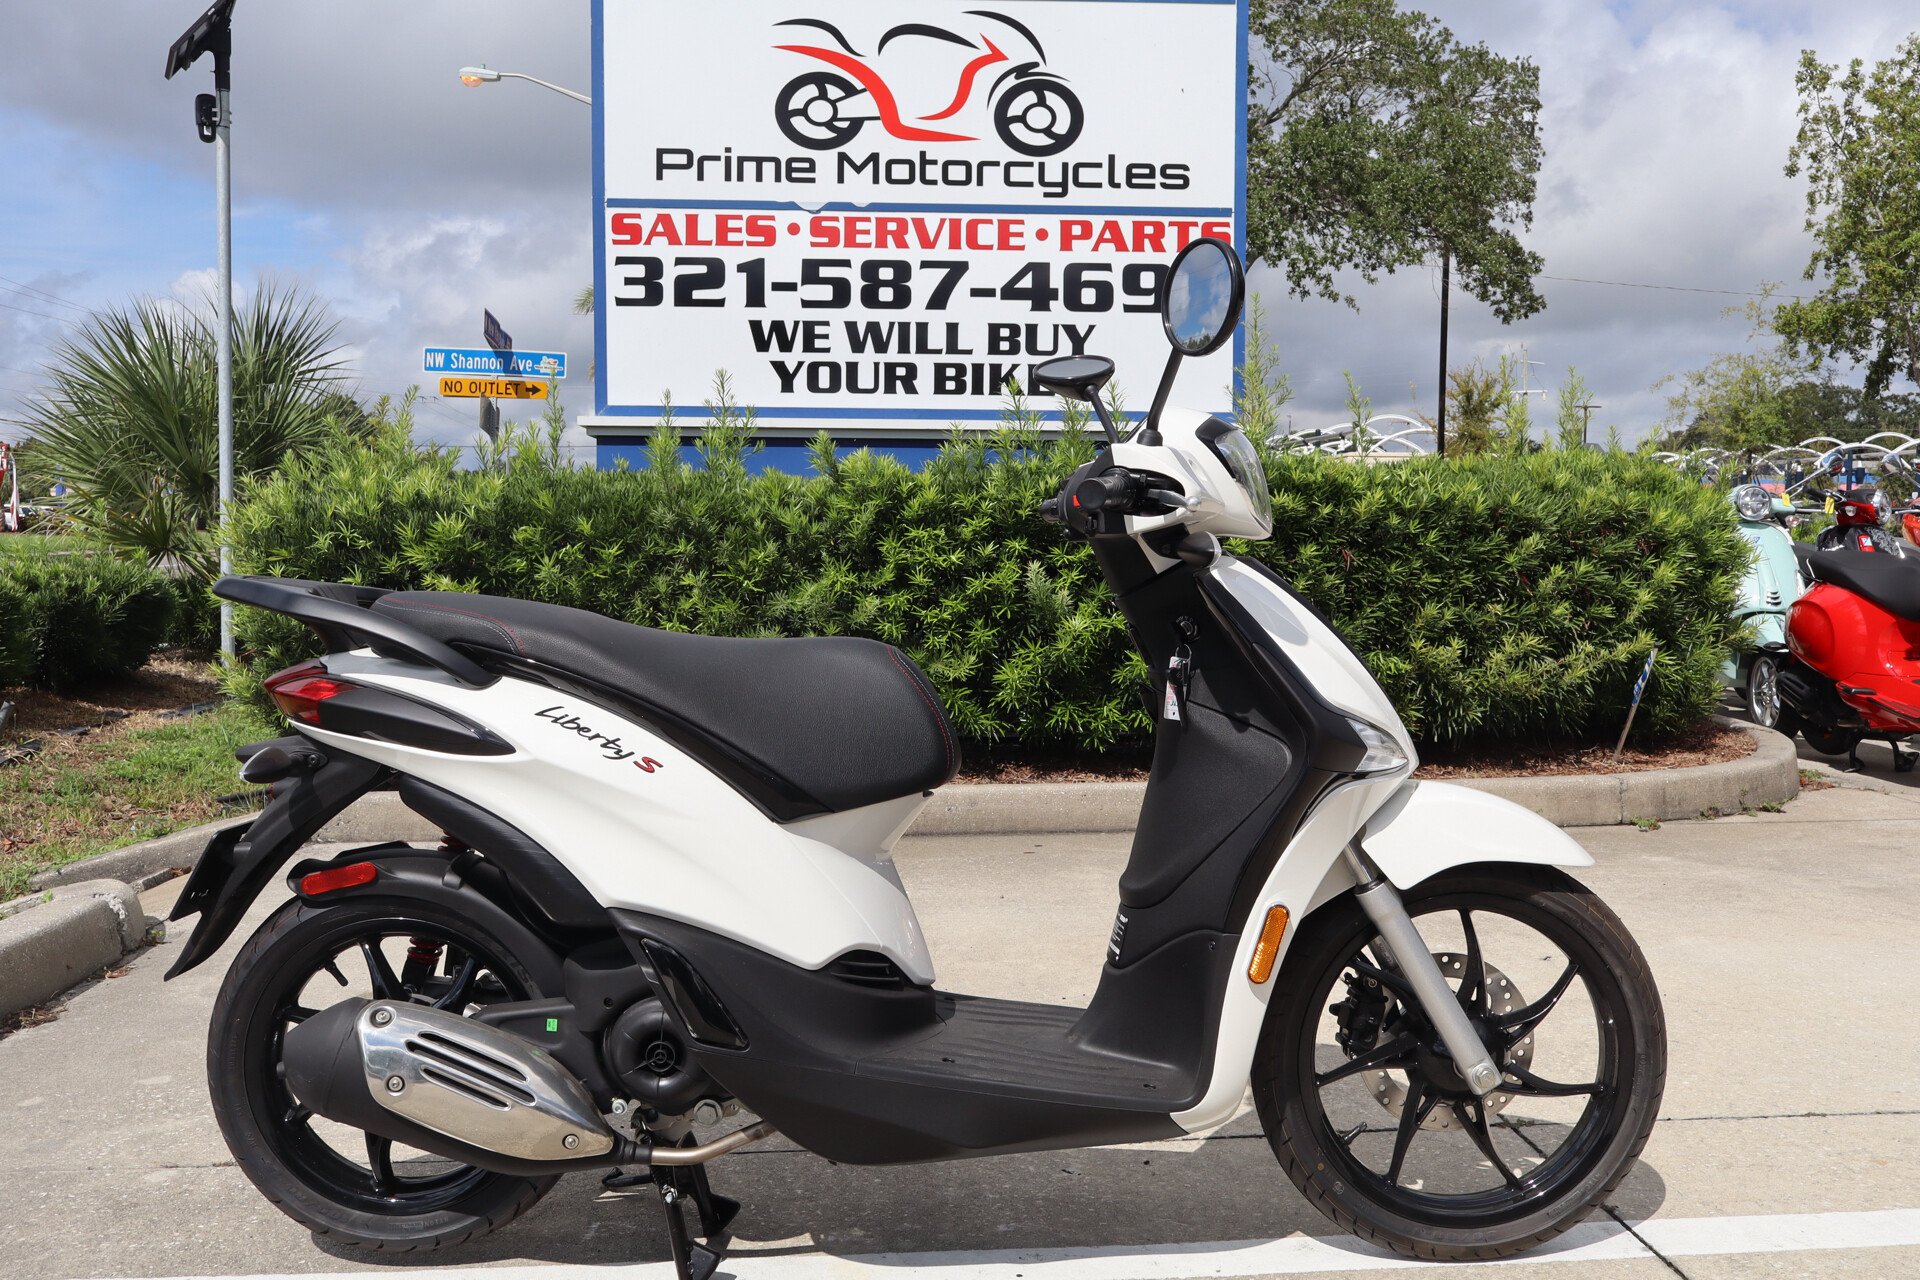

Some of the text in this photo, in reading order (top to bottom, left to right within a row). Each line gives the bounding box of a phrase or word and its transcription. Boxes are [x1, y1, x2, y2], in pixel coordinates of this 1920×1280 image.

[656, 146, 1190, 198] Prime Motorcycles
[611, 213, 777, 247] SALES
[809, 215, 1025, 251] SERVICE
[613, 256, 1171, 313] 321-587-469
[748, 319, 1097, 356] WE WILL BUY
[426, 351, 533, 372] NW Shannon Ave
[769, 360, 919, 395] YOUR
[443, 380, 521, 395] NO OUTLET
[534, 705, 664, 774] Liberty S
